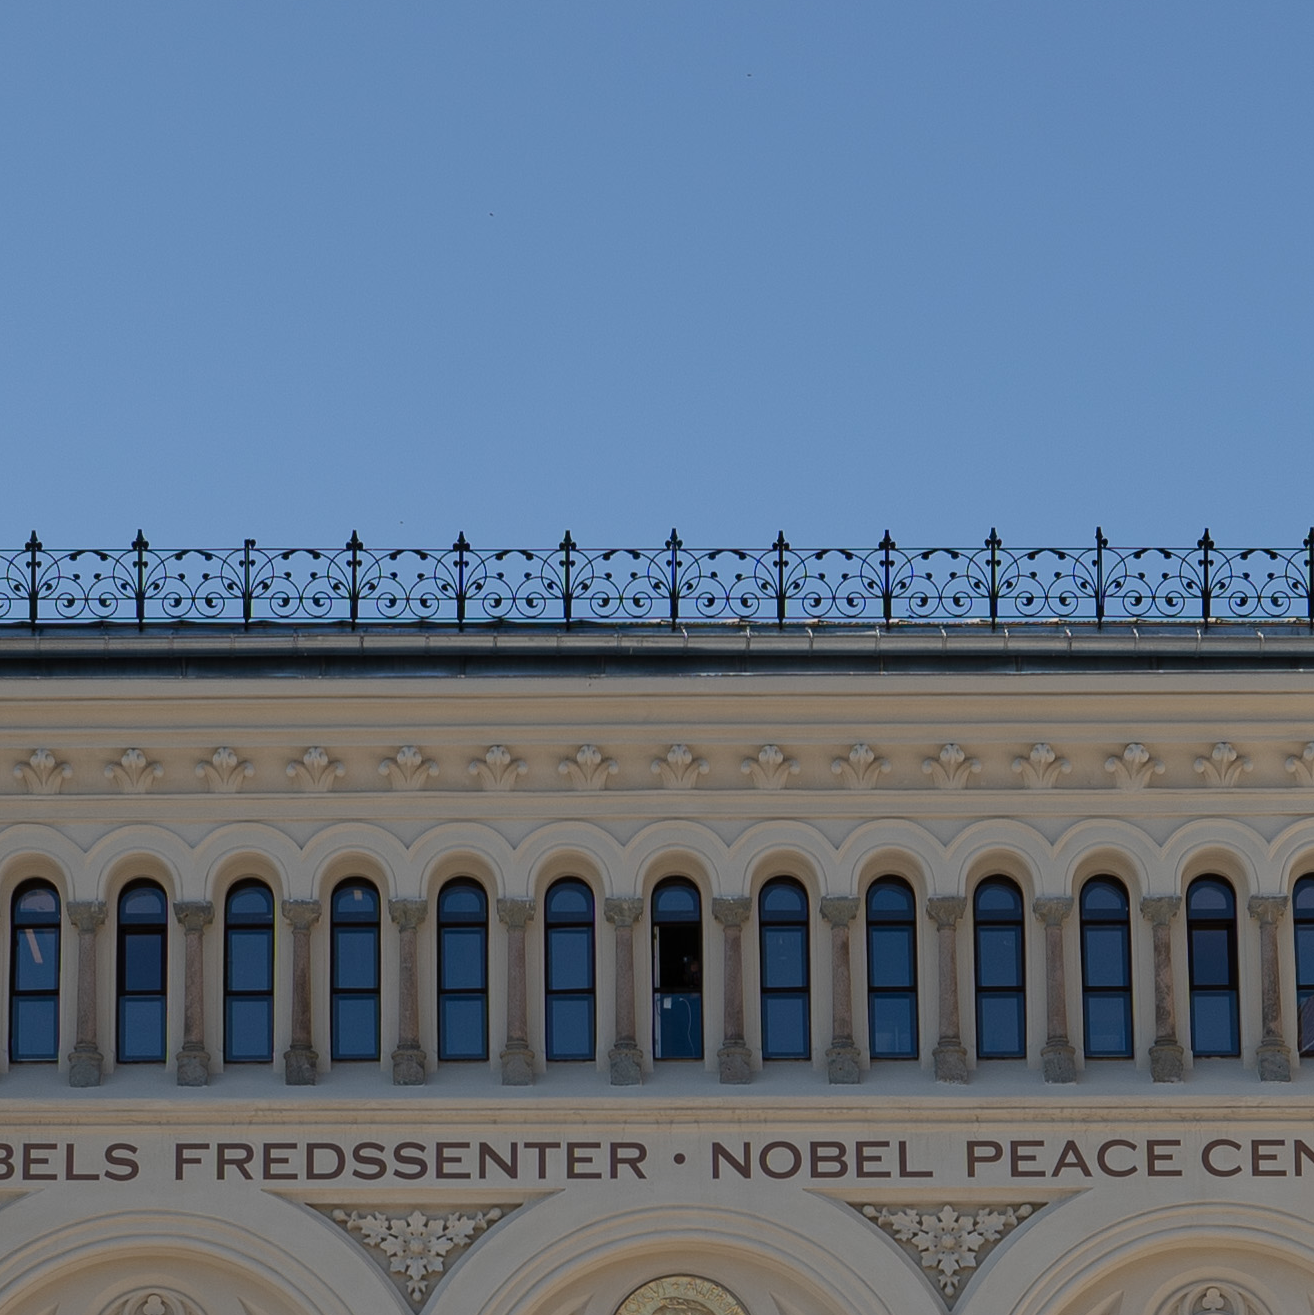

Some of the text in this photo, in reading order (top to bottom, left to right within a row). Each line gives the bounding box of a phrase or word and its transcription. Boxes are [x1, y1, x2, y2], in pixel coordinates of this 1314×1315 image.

[175, 1141, 648, 1181] FREDSSENTER
[712, 1140, 933, 1180] NOBEL
[967, 1139, 1183, 1179] PEACE
